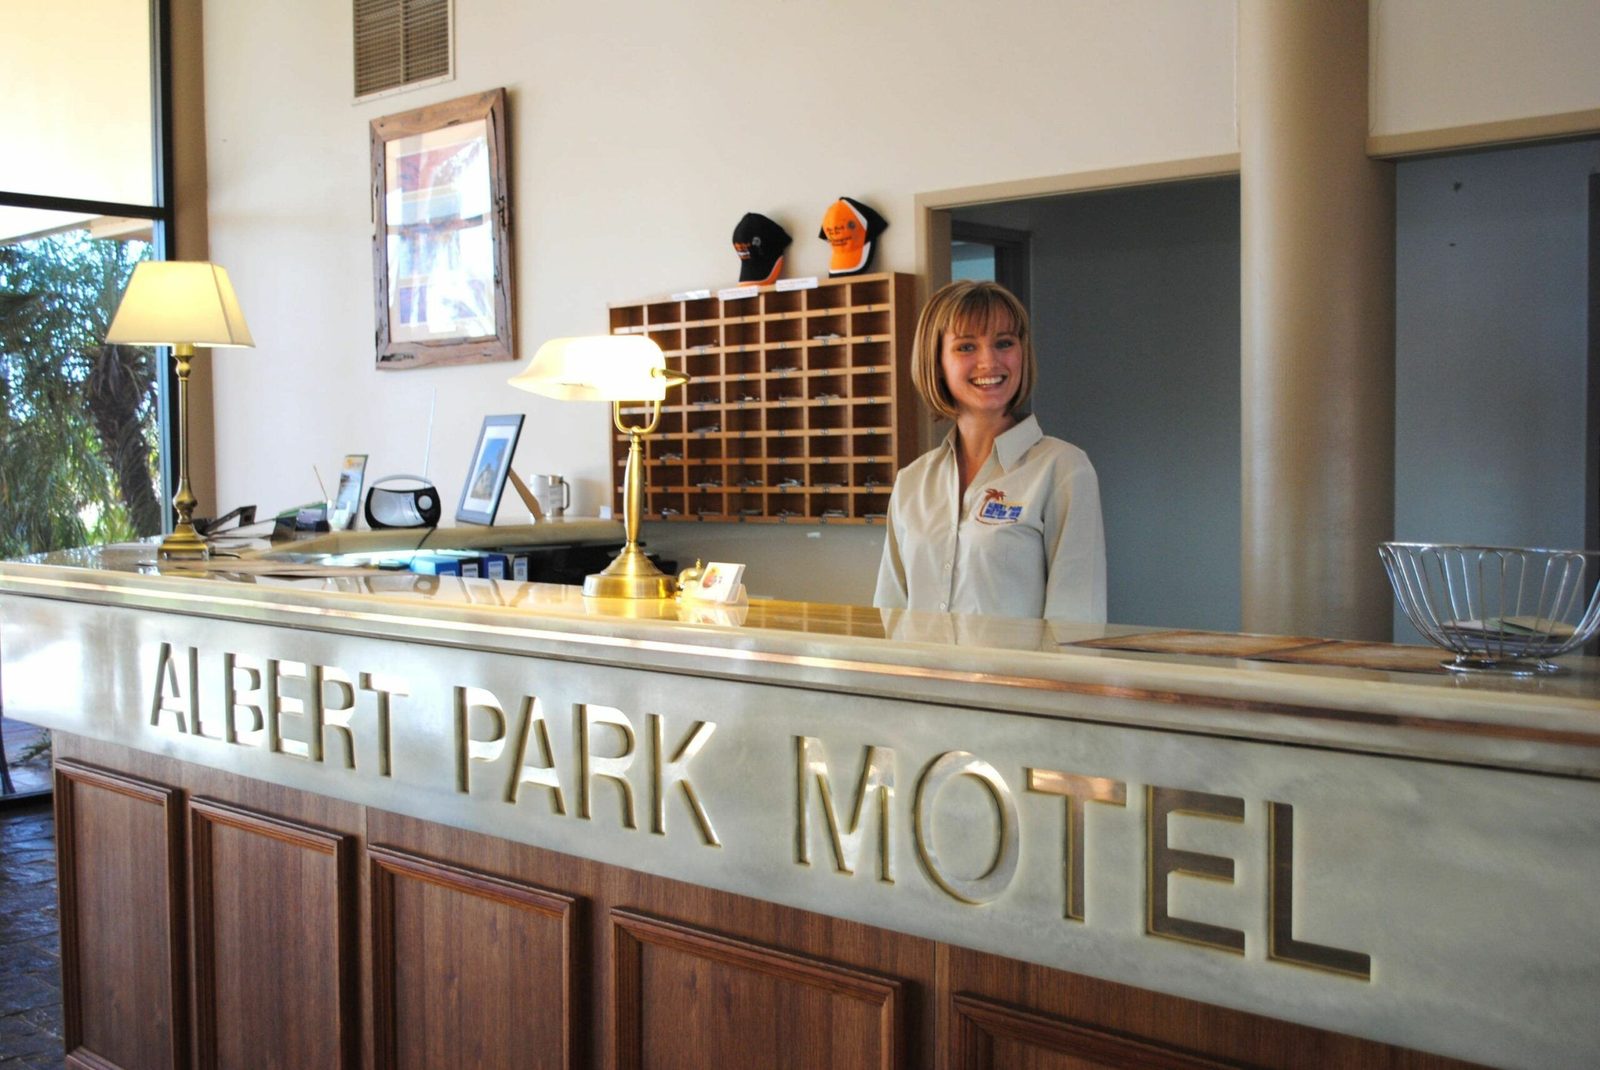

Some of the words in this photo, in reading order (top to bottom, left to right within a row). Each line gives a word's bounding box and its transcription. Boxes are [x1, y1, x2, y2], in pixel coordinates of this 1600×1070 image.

[150, 642, 409, 777] ALBERT
[453, 685, 721, 848] PARK
[795, 735, 1371, 982] MOTEL
